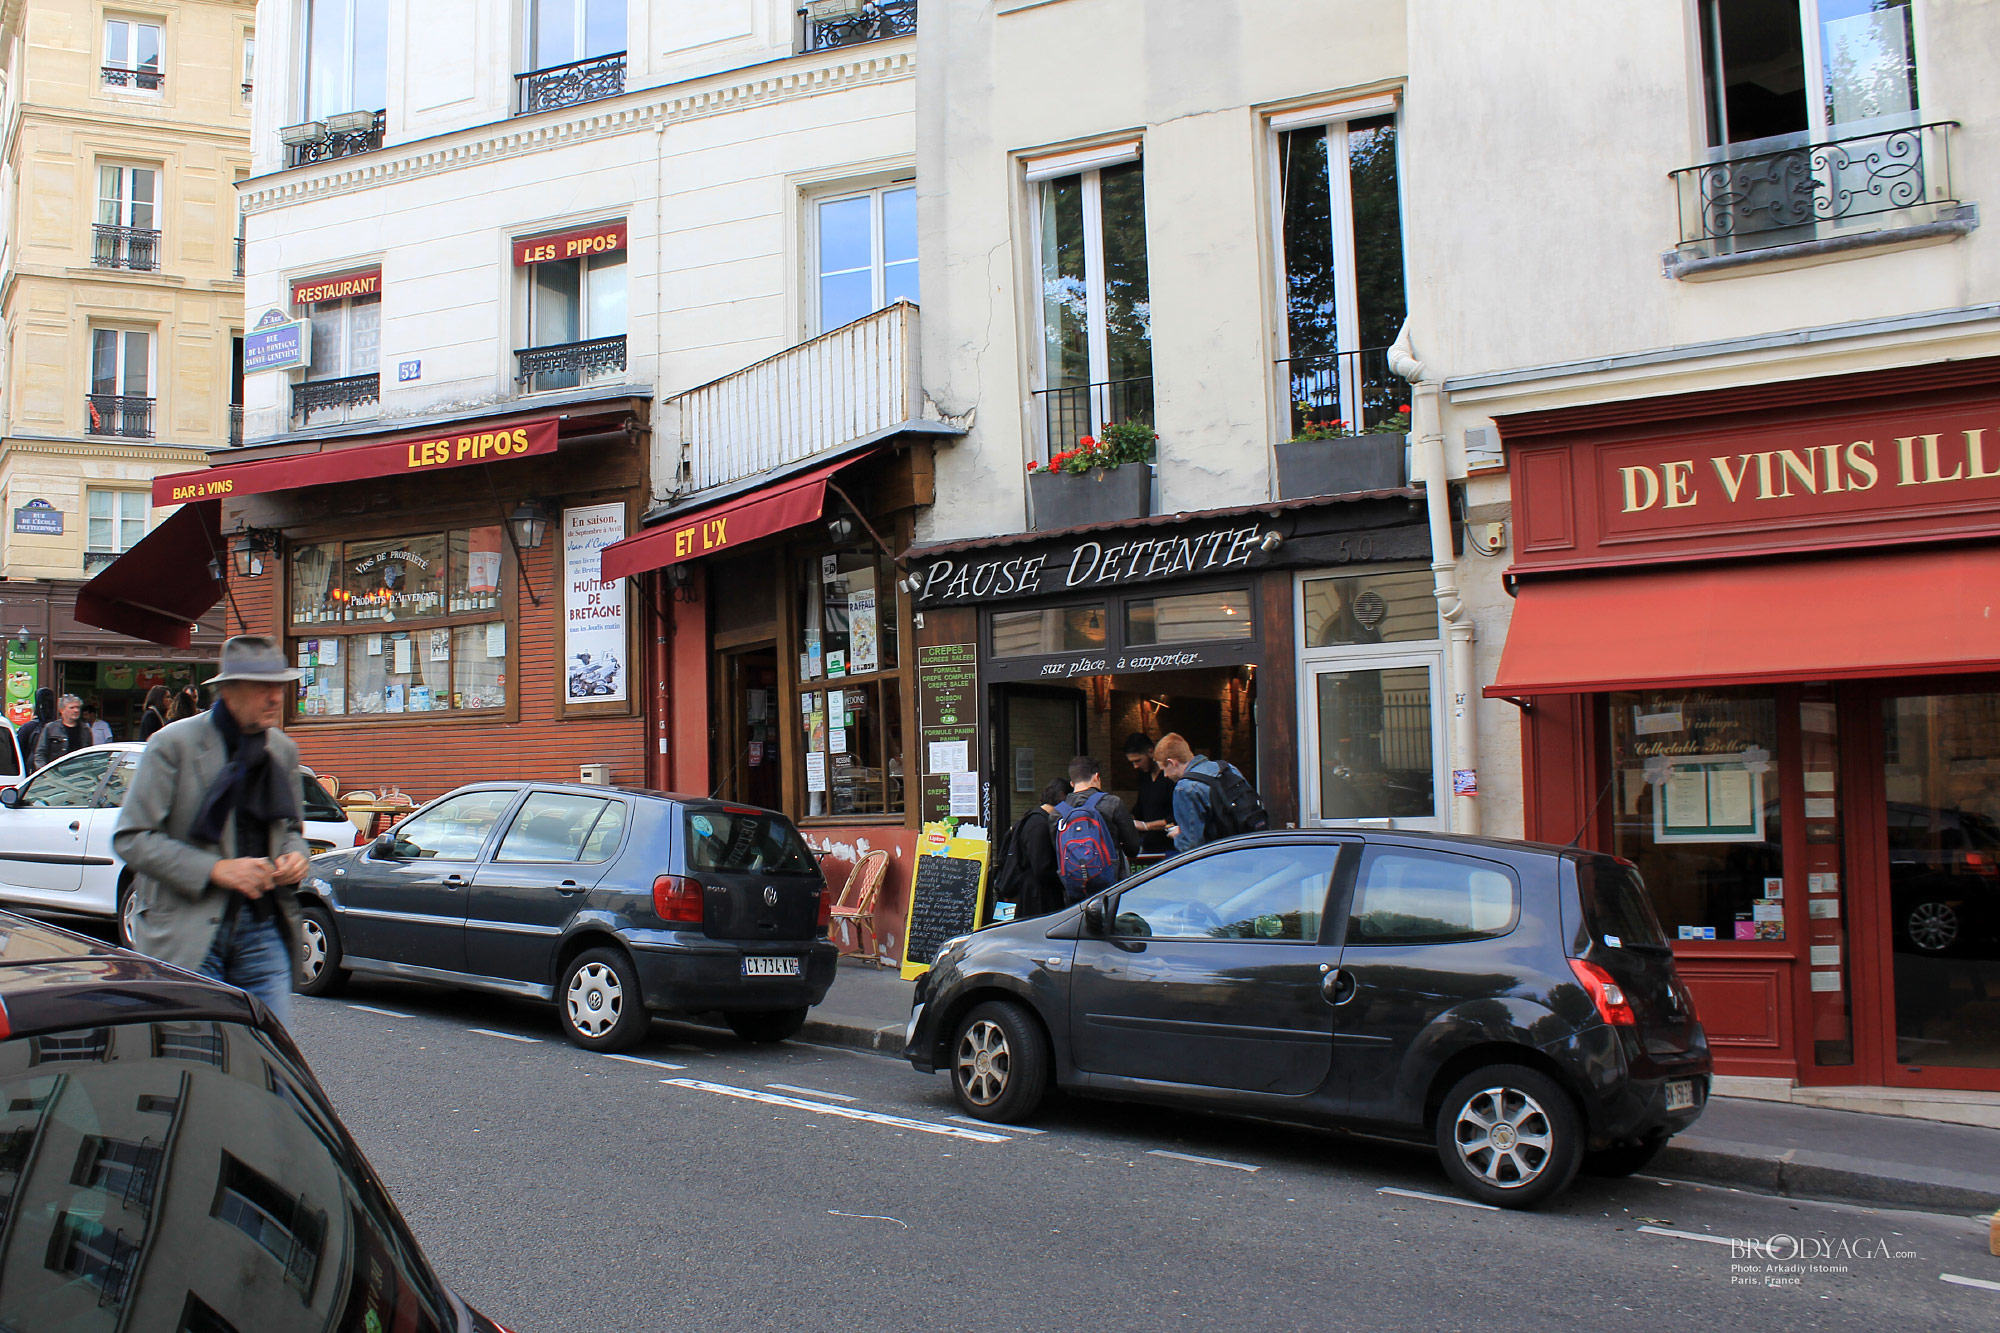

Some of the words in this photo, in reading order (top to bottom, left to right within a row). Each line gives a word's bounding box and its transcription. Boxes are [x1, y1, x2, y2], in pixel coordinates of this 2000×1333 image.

[524, 244, 556, 263] LES
[566, 233, 617, 257] PIPOS
[297, 276, 377, 303] RESTAURANT
[266, 334, 279, 343] RUE
[249, 348, 257, 357] DE
[257, 346, 265, 355] LA
[266, 339, 297, 352] MONTAGNE
[246, 355, 266, 367] SAINTE
[267, 348, 299, 361] GENEVIÈVE
[401, 361, 419, 379] 52
[408, 439, 450, 468] LES
[456, 428, 529, 461] PIPOS
[1619, 459, 1698, 514] DE
[1710, 439, 1879, 503] VINIS
[1894, 428, 2000, 487] ILL
[172, 484, 196, 500] BAR
[198, 484, 205, 497] à
[206, 479, 233, 495] VINS
[572, 517, 585, 528] En
[575, 528, 602, 537] Septembre
[675, 527, 696, 557] ET
[703, 517, 727, 549] L'X
[1339, 536, 1373, 563] 50
[919, 553, 1047, 602] PAUSE
[1065, 522, 1260, 587] DETENTE
[588, 593, 601, 605] DE
[569, 604, 621, 620] BRETAGNE
[928, 646, 963, 655] CREPES
[1040, 663, 1065, 676] sur
